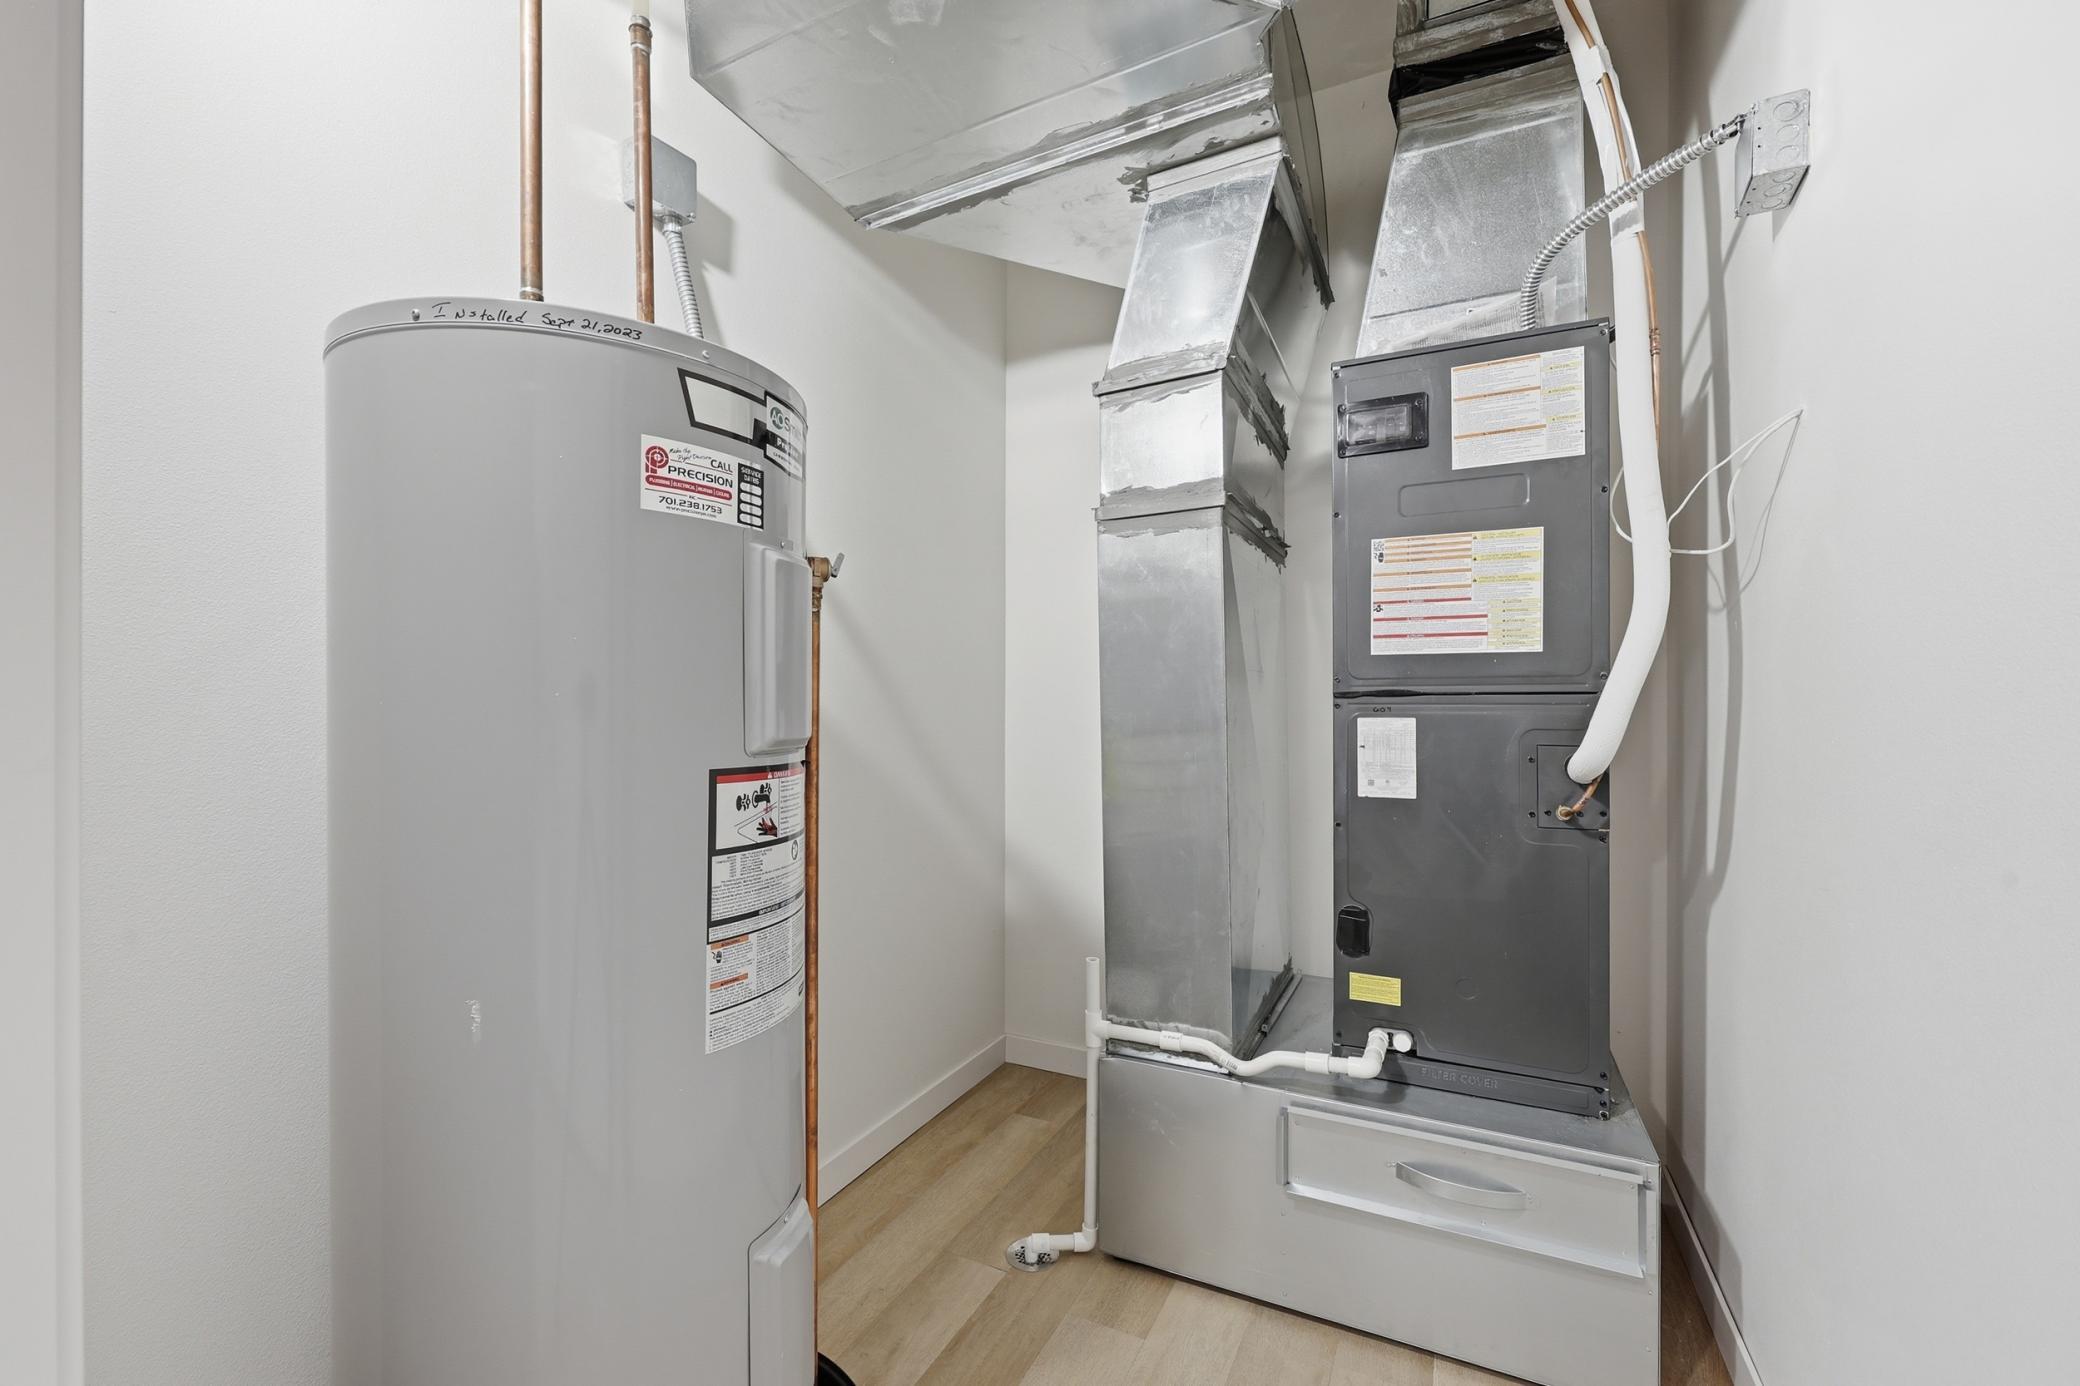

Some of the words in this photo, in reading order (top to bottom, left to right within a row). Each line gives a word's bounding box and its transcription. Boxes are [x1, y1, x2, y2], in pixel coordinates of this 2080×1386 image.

[541, 312, 575, 329] Sept
[710, 459, 733, 473] CALL
[667, 465, 733, 489] PRECISION
[658, 495, 723, 514] 701.238.1753
